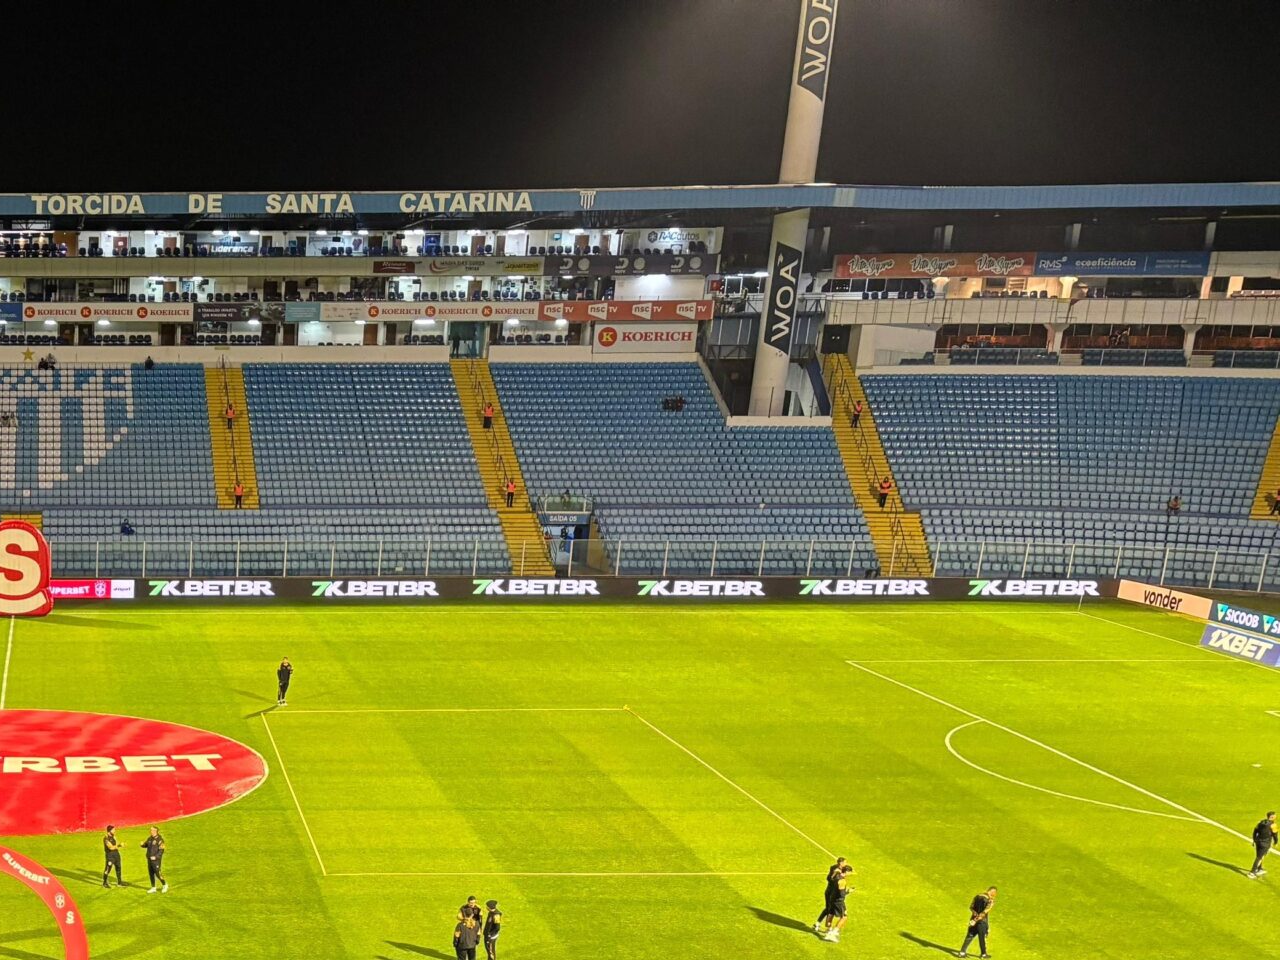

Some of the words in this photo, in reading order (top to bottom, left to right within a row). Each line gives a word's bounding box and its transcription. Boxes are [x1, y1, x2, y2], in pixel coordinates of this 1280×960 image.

[31, 195, 145, 215] TORCIDA
[189, 194, 223, 213] DE
[265, 193, 354, 213] SANTA
[399, 192, 533, 212] CATARINA
[1039, 260, 1062, 269] RMS
[678, 305, 695, 313] nsc
[697, 305, 707, 313] TV
[771, 258, 798, 342] WOA
[622, 331, 693, 342] KOERICH
[1144, 590, 1183, 611] vonder
[1225, 608, 1260, 628] SICOOB
[1208, 629, 1274, 661] 1XBET
[2, 852, 51, 885] SUPERBET
